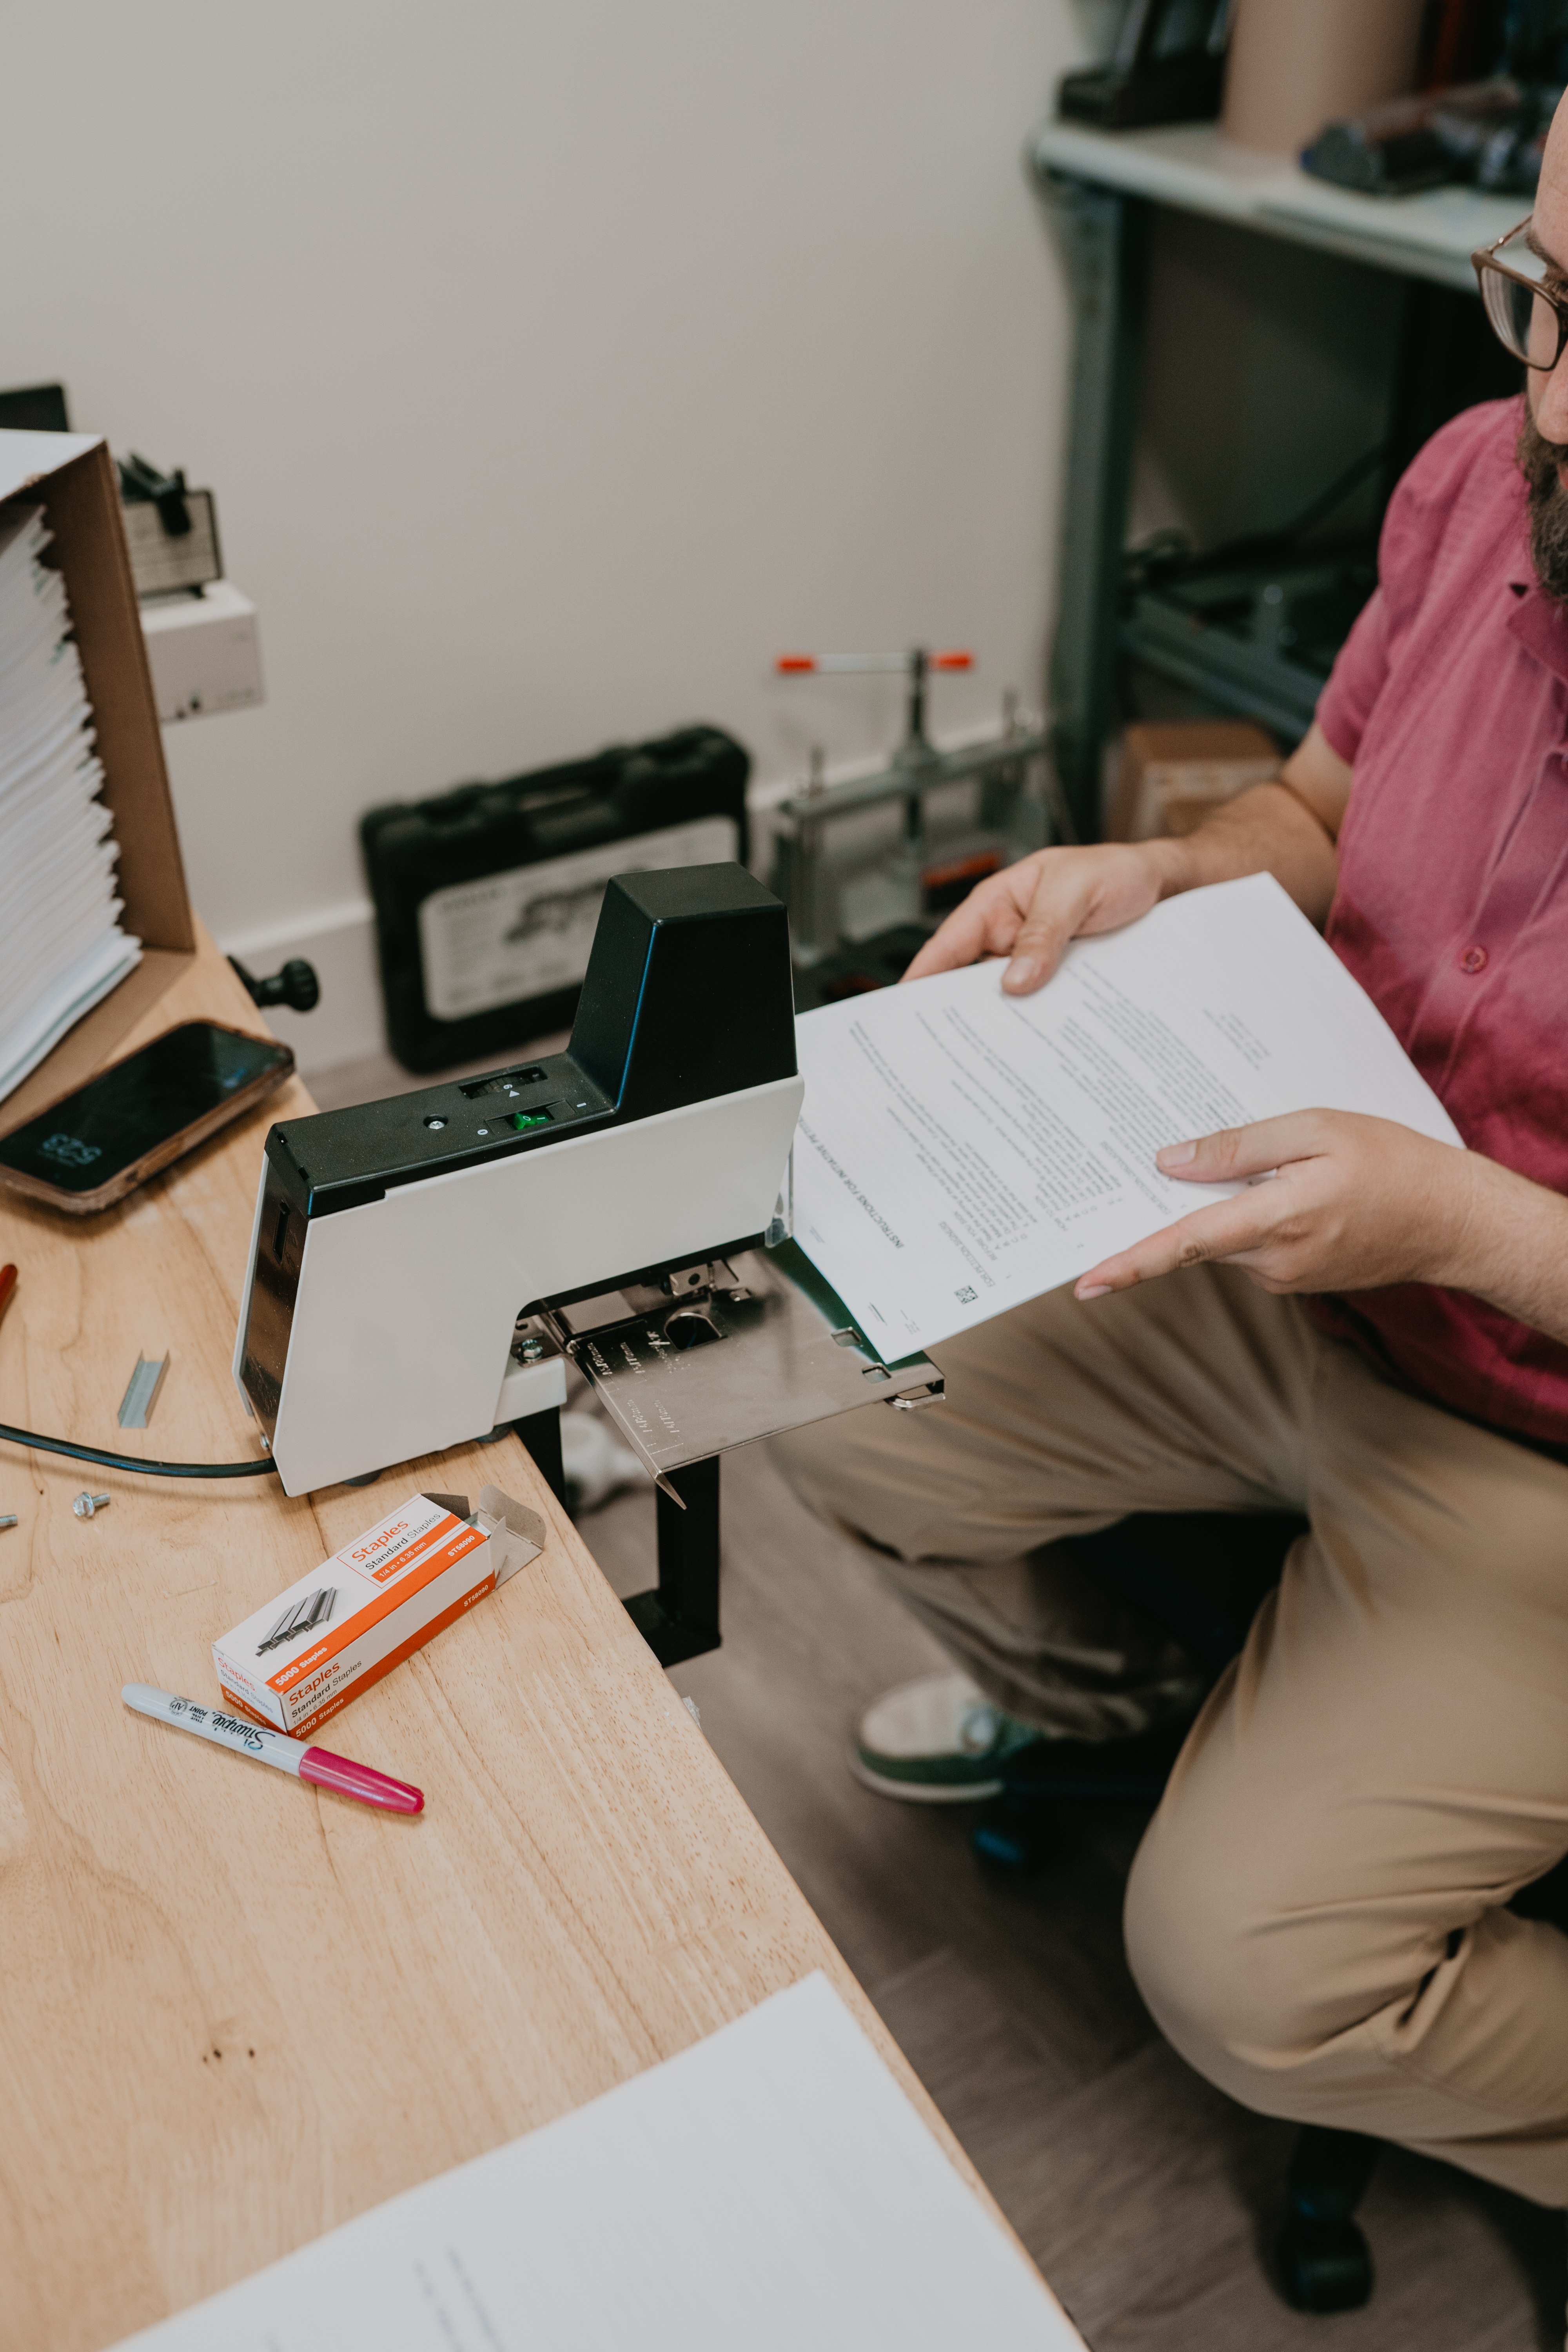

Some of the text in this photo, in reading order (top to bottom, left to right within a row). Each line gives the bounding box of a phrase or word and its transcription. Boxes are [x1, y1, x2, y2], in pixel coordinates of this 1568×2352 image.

[841, 1178, 861, 1194] FOR
[855, 1194, 905, 1249] INSTRUCTIONS
[352, 1521, 408, 1562] Staples
[365, 1514, 440, 1570] Standard Staples
[448, 1535, 475, 1556] ST58090
[379, 1568, 390, 1577] 1/4
[399, 1550, 414, 1562] 6.35
[414, 1542, 426, 1552] mm
[464, 1585, 488, 1606] ST58090
[218, 1657, 255, 1691] Staples
[275, 1647, 328, 1686] 5000 Staples
[289, 1662, 340, 1706] Staples
[221, 1670, 273, 1713] Standard Staples
[292, 1661, 362, 1718] Standard Staples
[313, 1698, 326, 1710] 6.35
[327, 1690, 337, 1700] mm
[189, 1706, 208, 1717] POINT
[190, 1713, 204, 1723] FINE
[226, 1691, 267, 1725] 5000 Staples
[296, 1698, 344, 1737] 5000 Staples
